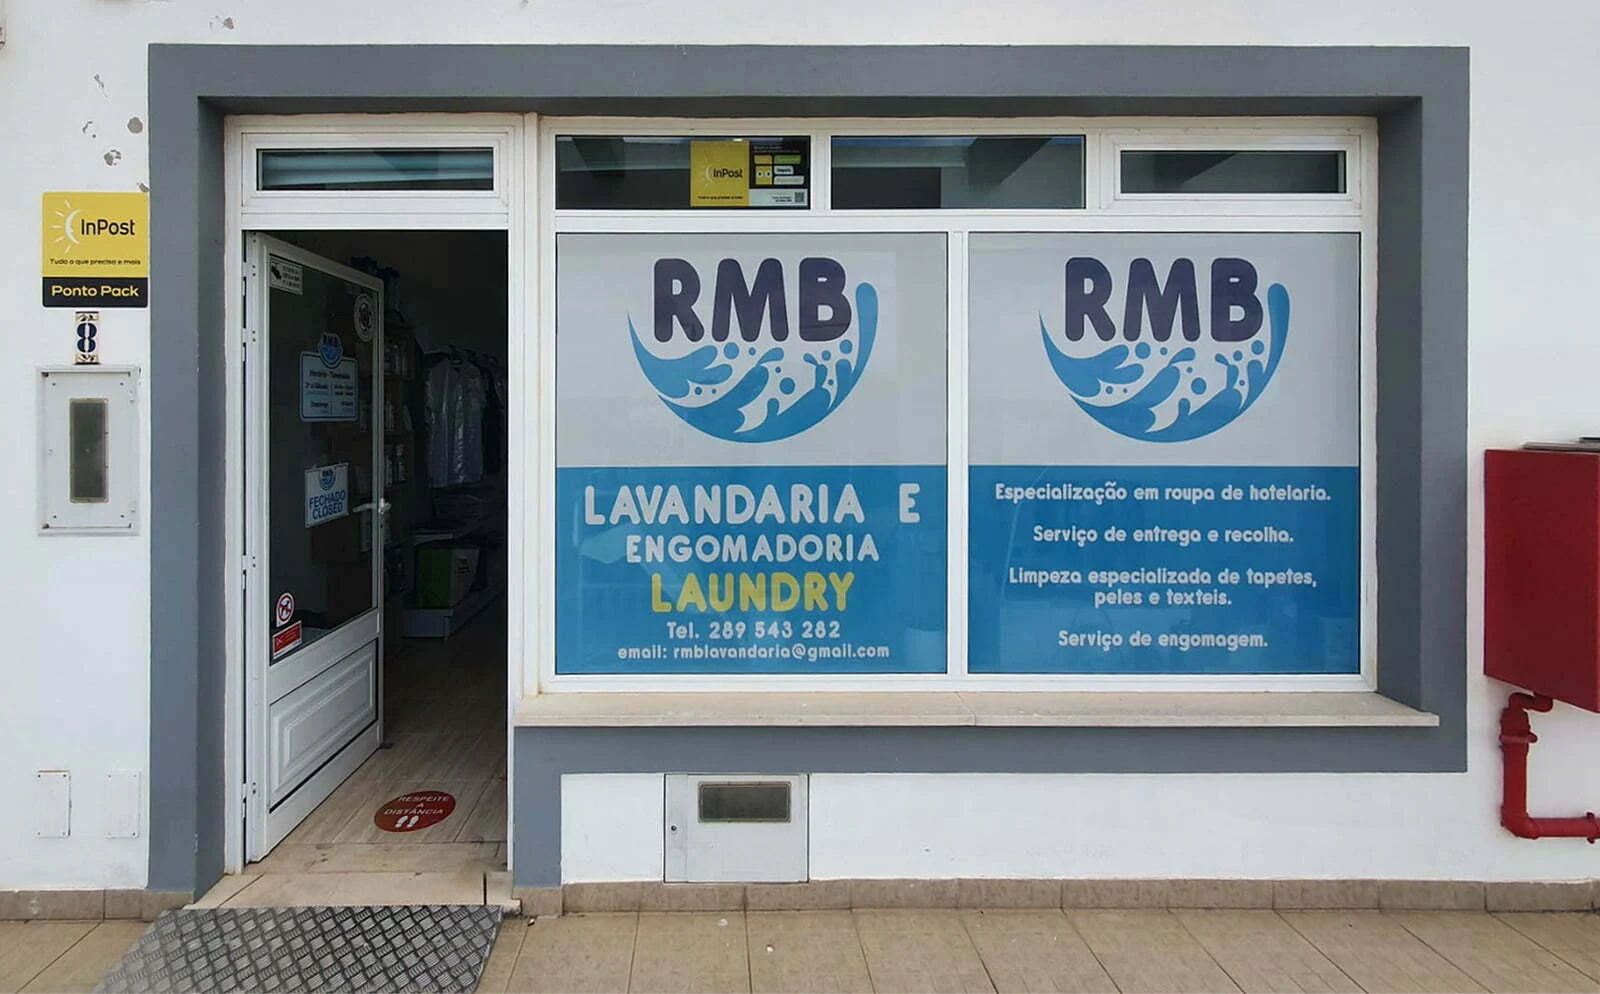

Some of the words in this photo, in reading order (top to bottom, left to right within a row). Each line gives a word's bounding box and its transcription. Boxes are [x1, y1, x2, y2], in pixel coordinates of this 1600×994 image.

[713, 168, 743, 178] InPost
[81, 219, 135, 235] InPost
[51, 285, 98, 297] Ponto
[100, 285, 139, 297] Pack
[654, 258, 852, 342] RMB
[1065, 257, 1263, 342] RMB
[77, 322, 97, 353] 8
[310, 490, 345, 510] FECHADO
[584, 484, 864, 525] LAVANDARIA
[898, 483, 920, 523] E
[995, 482, 1128, 505] Especialização
[1134, 486, 1159, 500] em
[1165, 486, 1214, 504] roupa
[1221, 484, 1243, 500] de
[1250, 484, 1331, 501] hotelaria.
[313, 502, 343, 519] CLOSED
[1033, 525, 1097, 547] Serviço
[1104, 526, 1126, 543] de
[1133, 526, 1201, 547] entrega
[1207, 529, 1218, 543] e
[1224, 526, 1294, 543] recolha.
[626, 533, 879, 563] ENGOMADORIA
[1009, 567, 1082, 588] Limpeza
[1088, 568, 1211, 587] especializada
[1218, 568, 1240, 584] de
[1246, 568, 1317, 588] tapetes,
[651, 572, 855, 613] LAUNDRY
[1095, 589, 1142, 608] peles
[1149, 592, 1160, 605] e
[1166, 589, 1232, 606] texteis.
[666, 621, 700, 639] Tel.
[709, 620, 746, 639] 289
[755, 621, 793, 639] 543
[802, 621, 840, 639] 282
[1058, 630, 1122, 651] Serviço
[1130, 630, 1152, 647] de
[1158, 634, 1268, 651] engomagem.
[618, 644, 667, 659] email:
[673, 644, 889, 662] rmblavandaria@gmail.com
